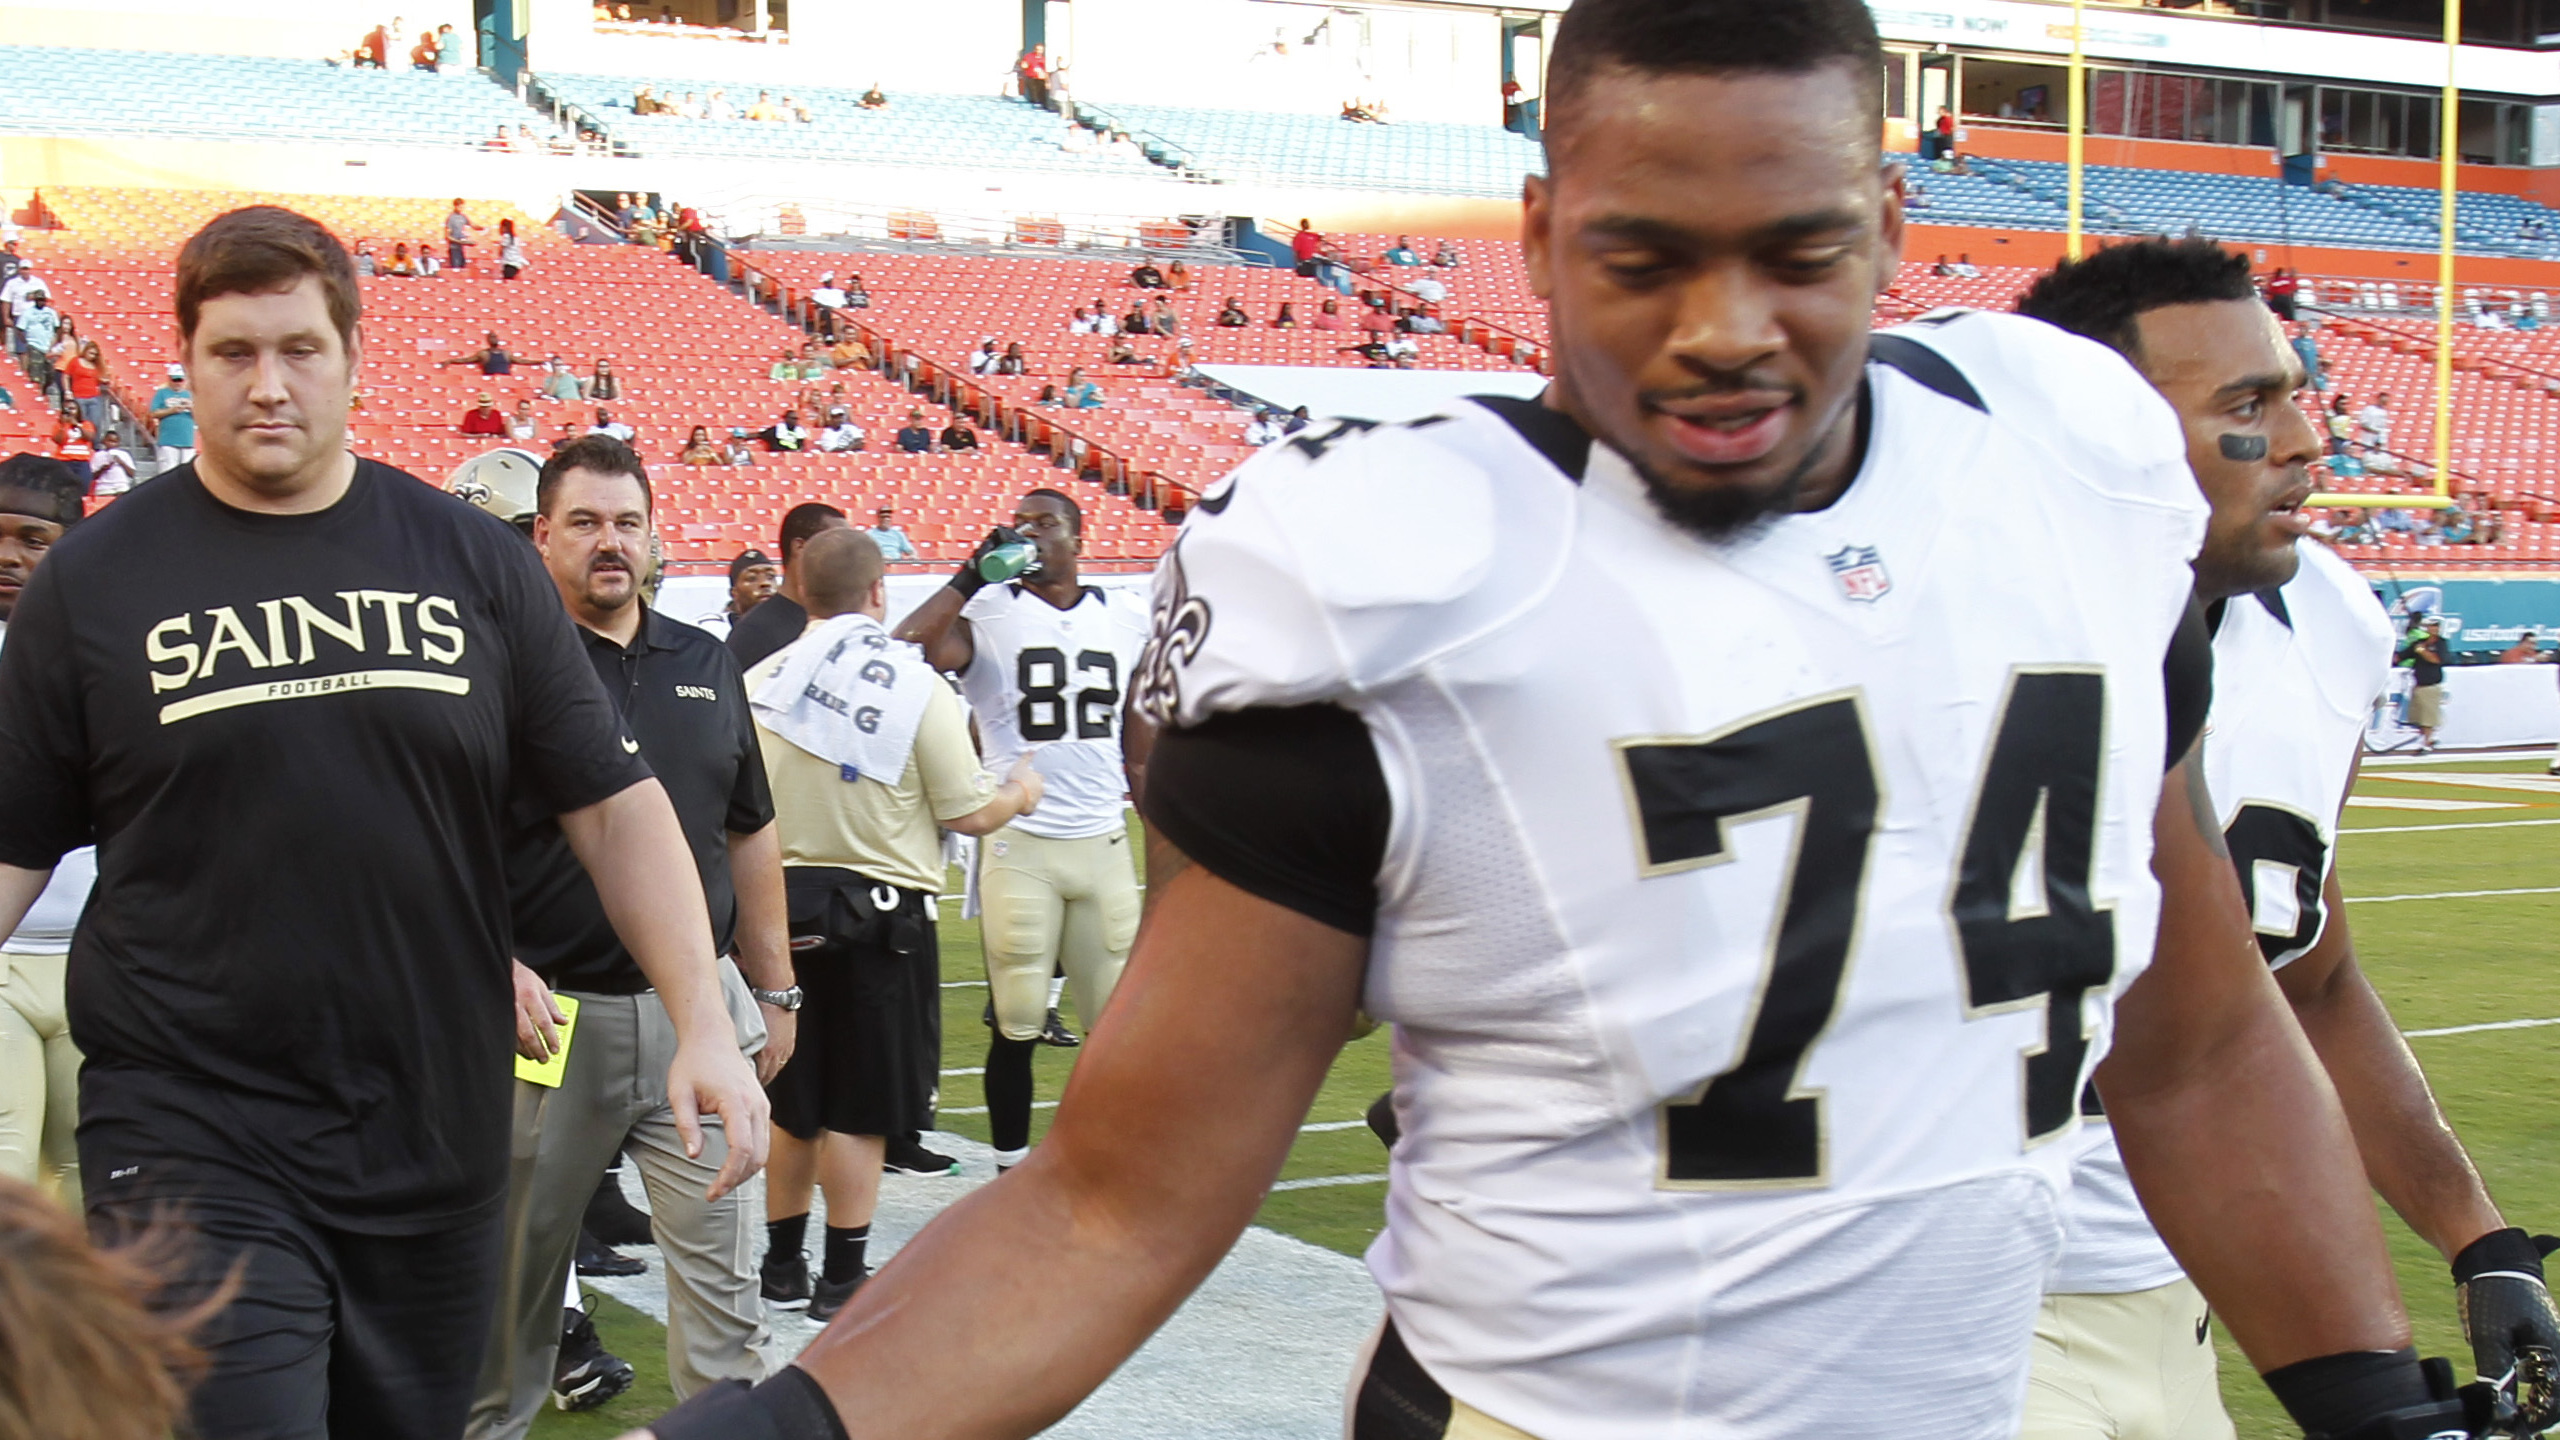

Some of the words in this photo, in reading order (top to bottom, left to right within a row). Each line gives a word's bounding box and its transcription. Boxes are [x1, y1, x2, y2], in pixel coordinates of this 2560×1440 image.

[146, 590, 465, 694] SAINTS
[268, 674, 372, 696] FOOTBALL
[675, 685, 717, 701] SAINTS
[1017, 647, 1119, 741] 82
[1608, 662, 2120, 1191] 74
